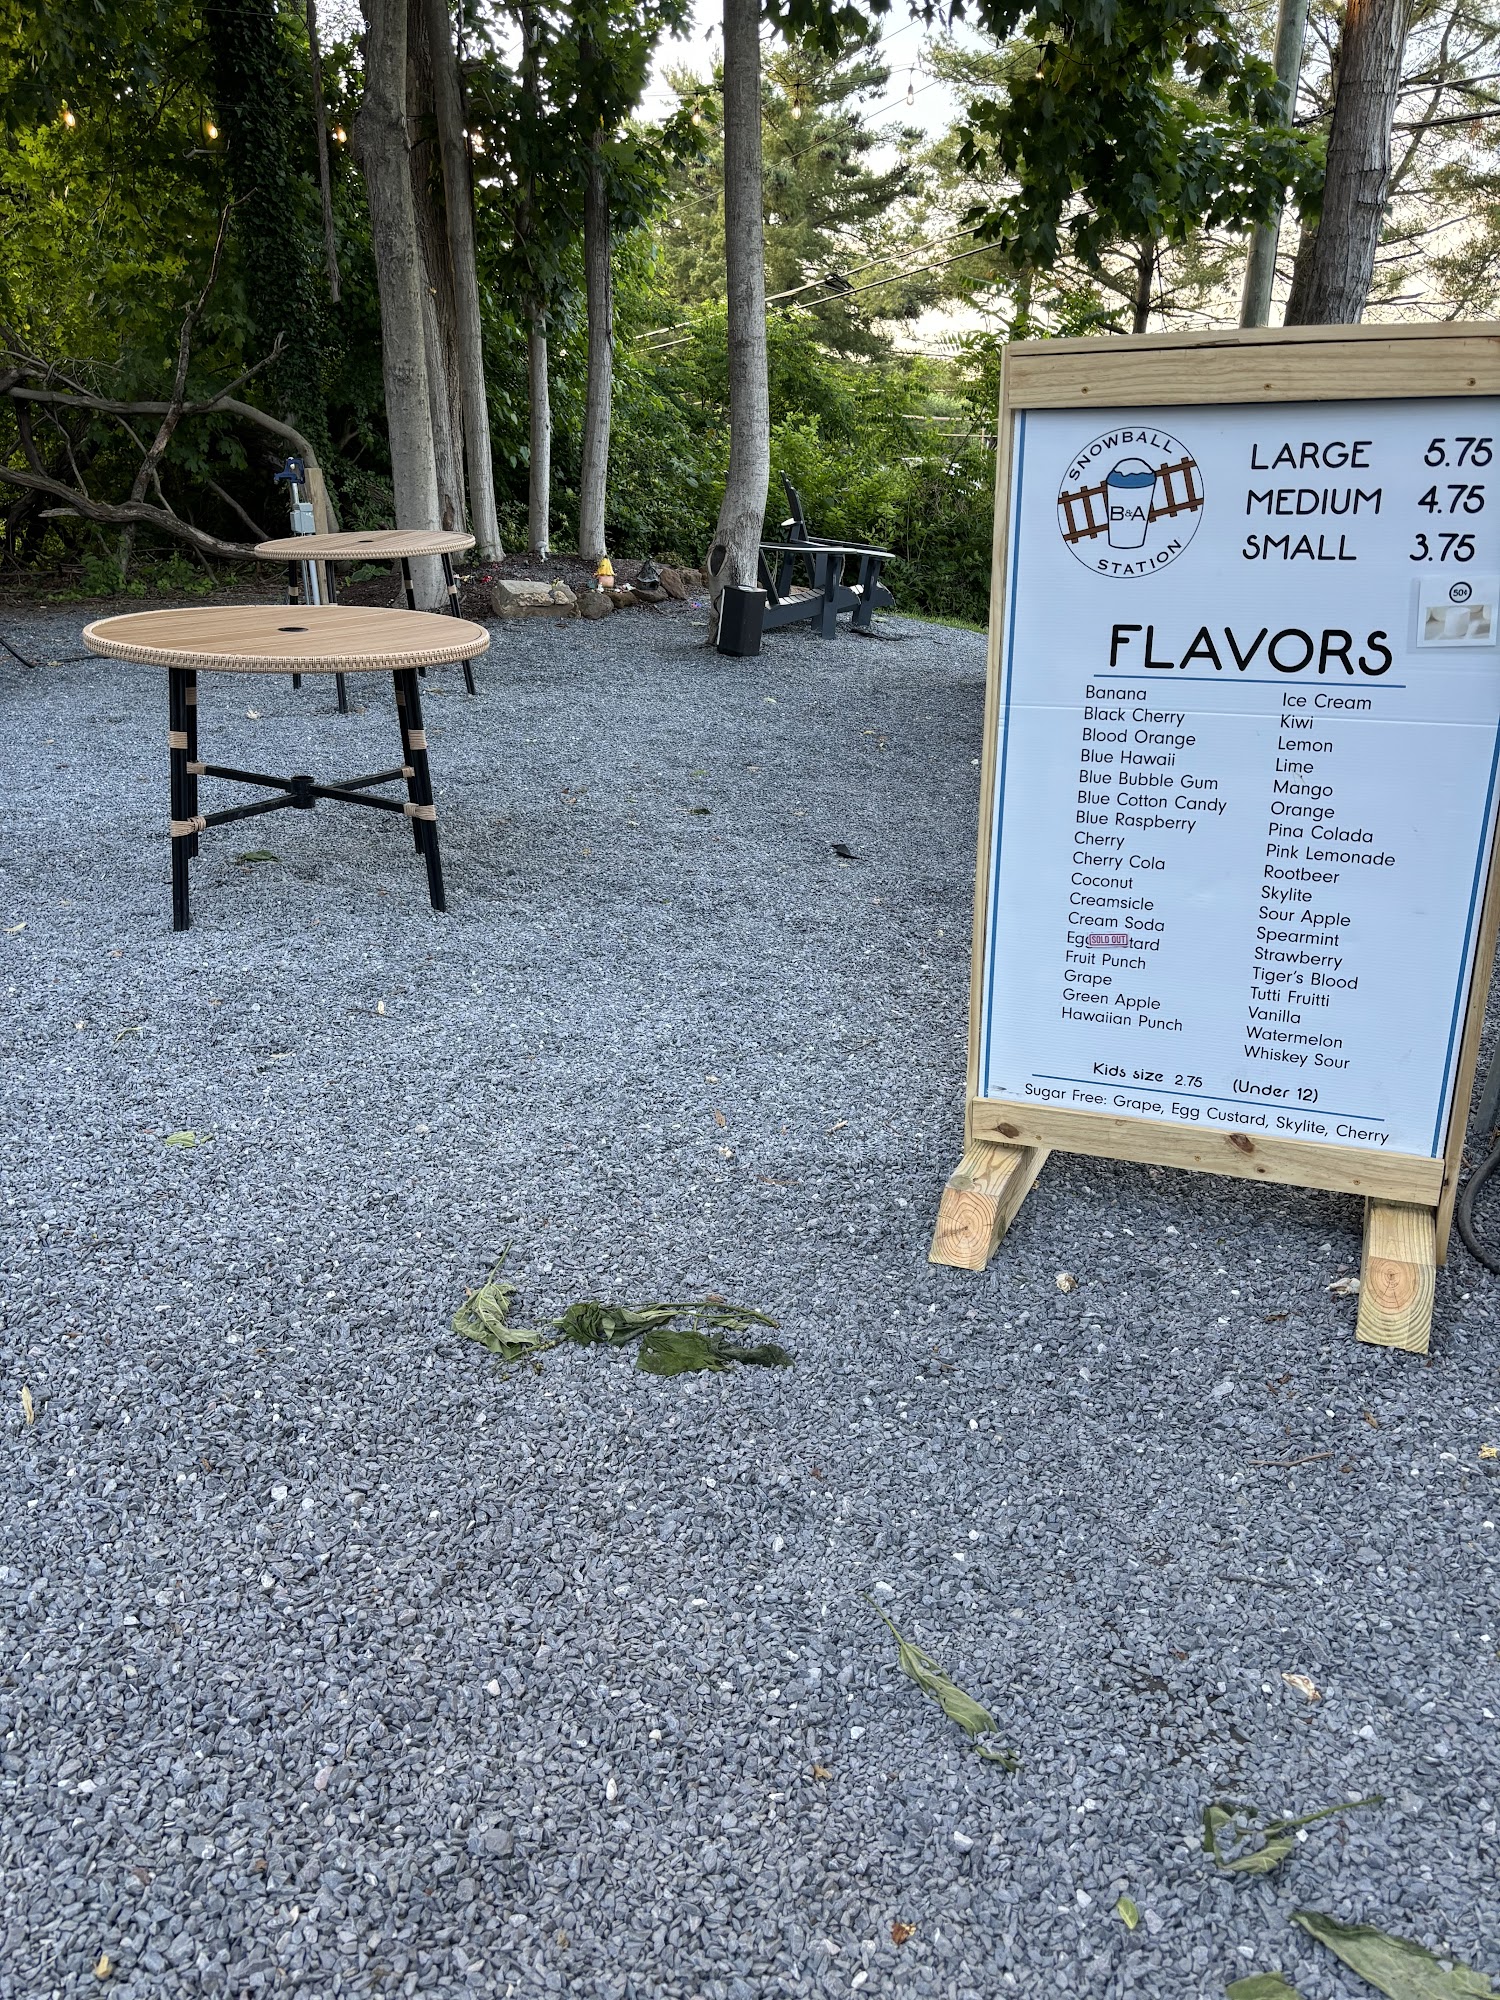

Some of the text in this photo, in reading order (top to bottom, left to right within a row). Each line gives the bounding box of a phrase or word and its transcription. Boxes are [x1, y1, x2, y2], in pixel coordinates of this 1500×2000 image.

[1068, 431, 1174, 481] SNOWBALL
[1251, 437, 1493, 470] LARGE 5.75
[1246, 484, 1485, 515] MEDIUM 4.75
[1098, 539, 1181, 575] STATION
[1242, 533, 1476, 562] SMALL 3.75
[1453, 588, 1468, 597] 50¢
[1110, 624, 1392, 676] FLAVORS
[1086, 685, 1146, 700] Banana
[1283, 692, 1371, 710] Ice Cream
[1084, 706, 1185, 728] Black Cherry
[1280, 714, 1314, 729] Kiwi
[1082, 727, 1196, 749] Blood Orange
[1278, 736, 1333, 752] Lemon
[1081, 748, 1175, 766] Blue Hawaii
[1275, 758, 1314, 774] Lime
[1079, 769, 1218, 790] Blue Bubble Gum
[1273, 780, 1333, 799] Mango
[1078, 790, 1227, 815] Blue Cotton Candy
[1271, 801, 1335, 822] Orange
[1076, 810, 1196, 834] Blue Raspberry
[1269, 822, 1373, 843] Pina Colada
[1074, 831, 1125, 850] Cherry
[1073, 851, 1165, 871] Cherry Cola
[1266, 843, 1395, 866] Pink Lemonade
[1071, 872, 1133, 889] Coconut
[1264, 864, 1340, 883] Rootbeer
[1070, 892, 1154, 911] Creamsicle
[1261, 885, 1312, 904] Skylite
[1068, 911, 1165, 932] Cream Soda
[1259, 906, 1351, 929] Sour Apple
[1091, 935, 1126, 944] SOLD OUT
[1257, 926, 1339, 947] Spearmint
[1066, 950, 1146, 969] Fruit Punch
[1254, 946, 1343, 971] Strawberry
[1064, 969, 1112, 987] Grape
[1252, 966, 1358, 990] Tiger's Blood
[1063, 988, 1160, 1011] Green Apple
[1250, 986, 1330, 1007] Tutti Fruitti
[1062, 1006, 1182, 1031] Hawaiian Punch
[1248, 1006, 1301, 1024] Vanilla
[1246, 1025, 1342, 1051] Watermelon
[1244, 1044, 1350, 1069] Whiskey Sour
[1093, 1062, 1203, 1088] Kids size 2.75
[1233, 1079, 1318, 1103] (Under 12)
[1025, 1083, 1389, 1146] Sugar Free: Grape, Egg Custard, Skylite, Cherry
